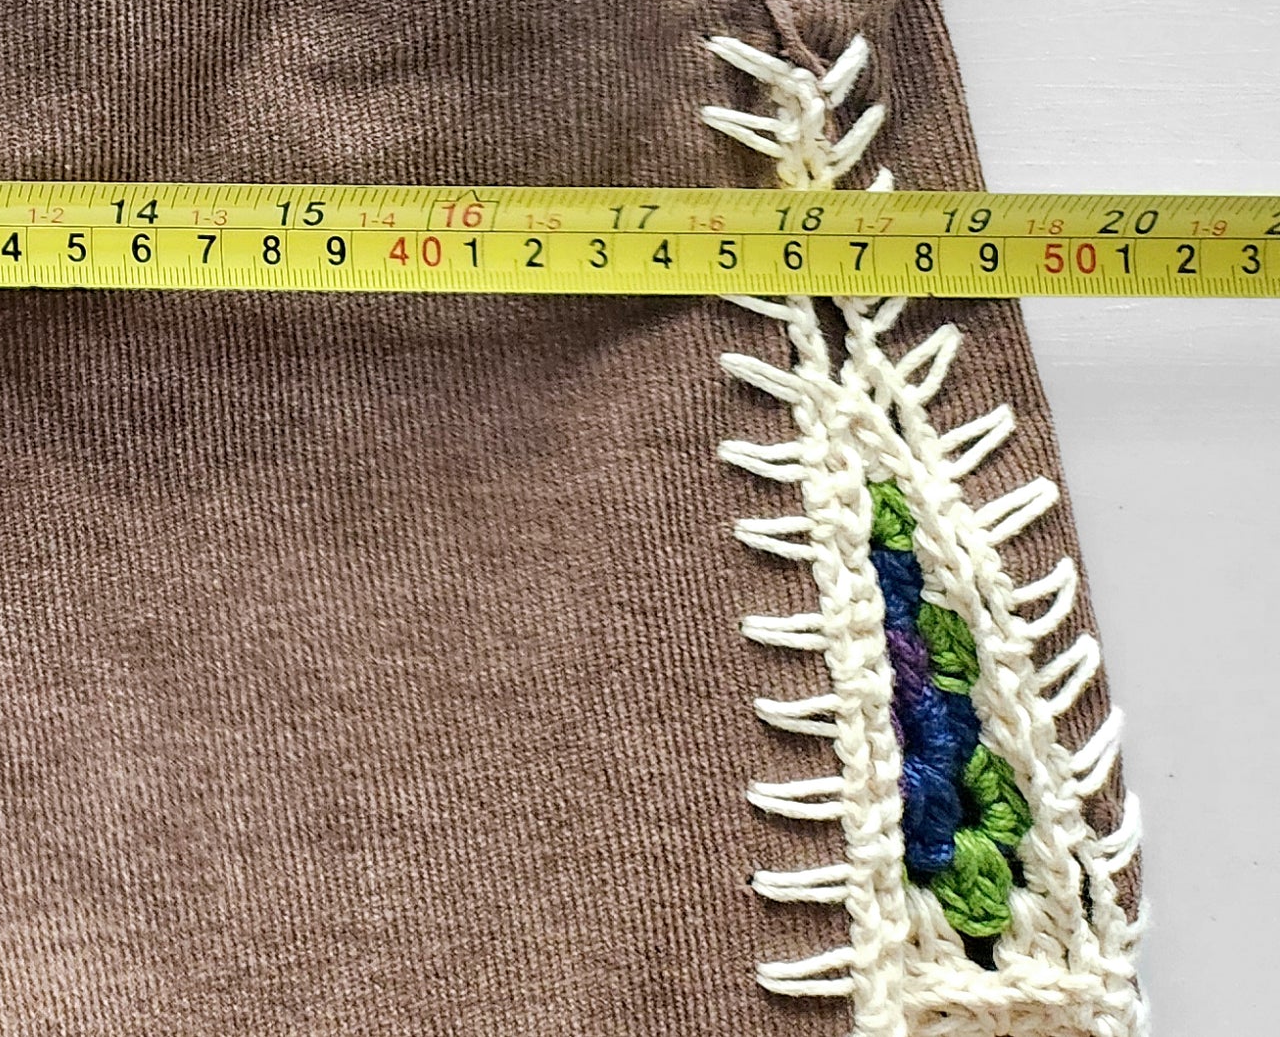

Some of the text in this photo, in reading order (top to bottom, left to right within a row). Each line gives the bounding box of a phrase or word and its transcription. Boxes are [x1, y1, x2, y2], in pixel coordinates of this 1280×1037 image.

[30, 207, 63, 223] 1-2
[111, 199, 159, 224] 14
[194, 209, 228, 226] 1-3
[276, 201, 325, 226] 15
[360, 212, 396, 228] 1-4
[442, 202, 484, 228] 16
[527, 214, 562, 230] 1-5
[610, 204, 660, 229] 17
[689, 215, 724, 231] 1-6
[776, 207, 824, 232] 18
[857, 217, 893, 233] 1-7
[944, 208, 991, 233] 19
[1028, 219, 1064, 235] 1-8
[1097, 210, 1158, 234] 20
[1191, 220, 1228, 236] 1-9
[1, 232, 22, 262] 4
[67, 233, 87, 262] 5
[132, 233, 151, 263] 6
[197, 234, 217, 263] 7
[263, 235, 281, 265] 8
[326, 235, 346, 265] 9
[389, 237, 441, 267] 40
[464, 238, 478, 267] 1
[525, 238, 545, 267] 2
[589, 239, 608, 268] 3
[652, 240, 673, 269] 4
[718, 240, 737, 269] 5
[783, 241, 803, 271] 6
[849, 242, 869, 271] 7
[915, 242, 933, 272] 8
[979, 243, 998, 272] 9
[1044, 243, 1096, 274] 50
[1116, 244, 1130, 274] 1
[1176, 244, 1197, 274] 2
[1242, 244, 1261, 274] 3
